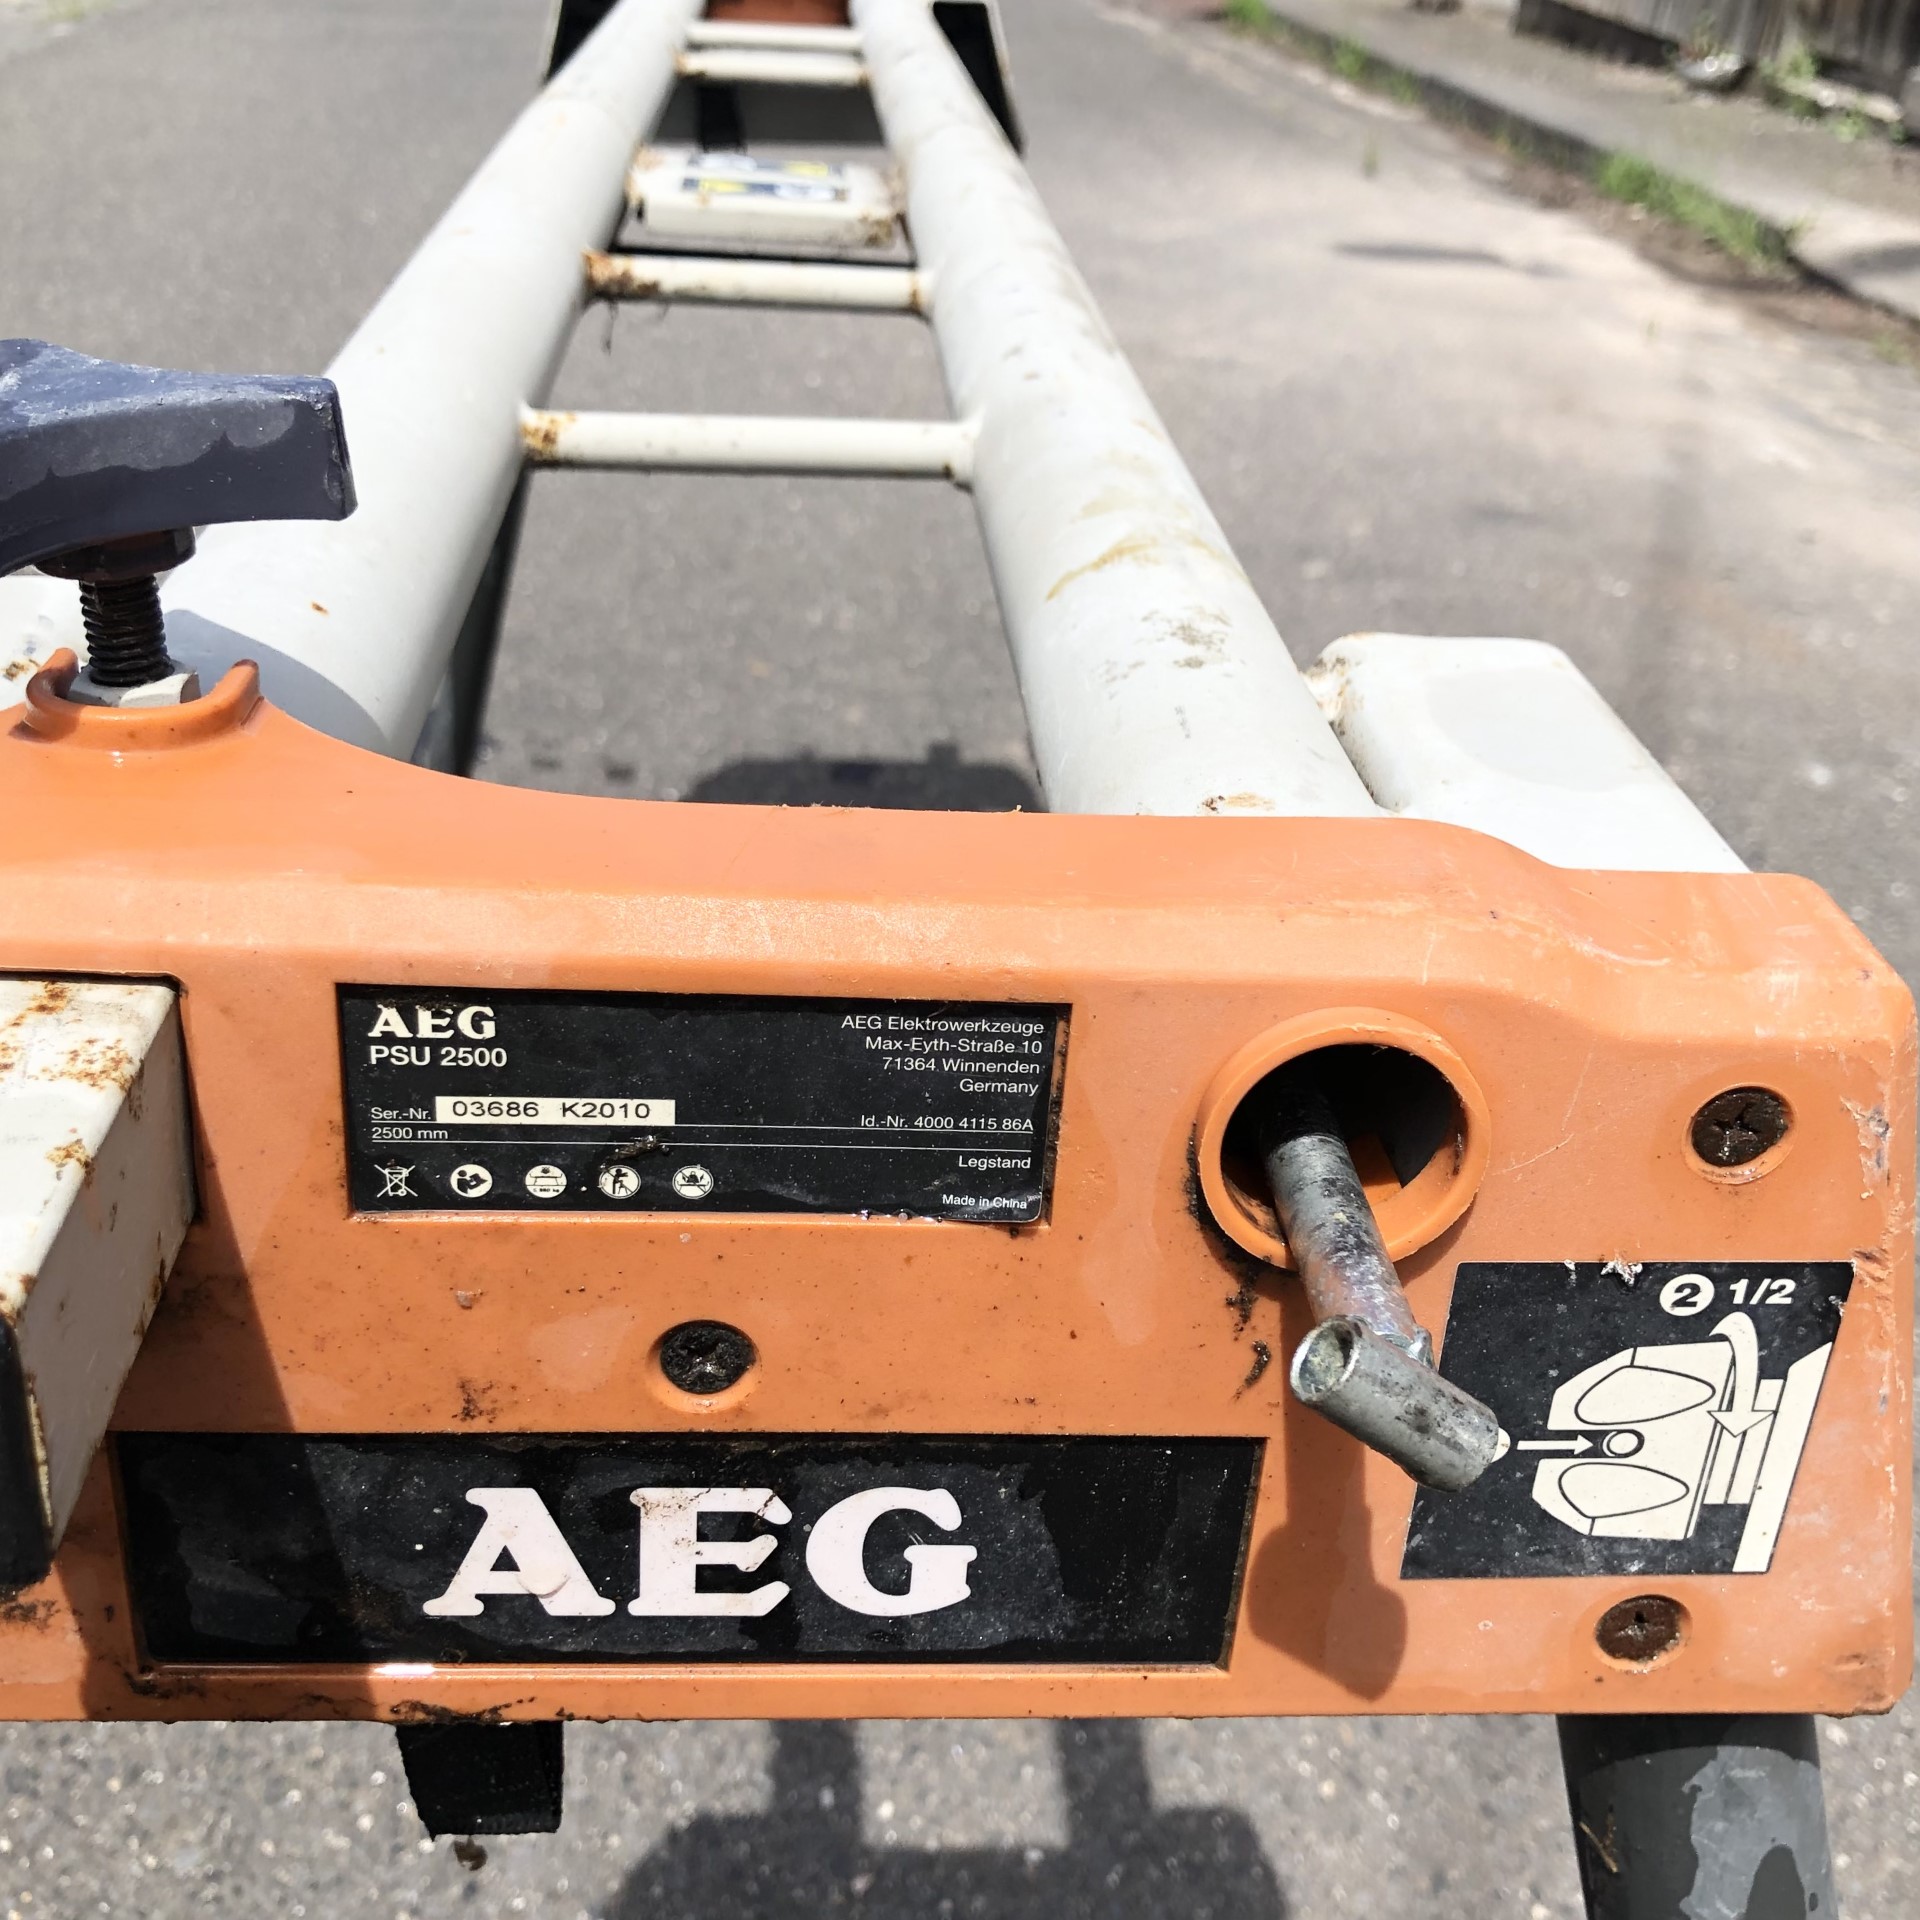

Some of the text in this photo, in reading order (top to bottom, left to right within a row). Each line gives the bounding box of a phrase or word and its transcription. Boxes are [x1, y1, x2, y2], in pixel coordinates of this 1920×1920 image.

[368, 1004, 496, 1040] AEG
[841, 1015, 1044, 1034] AEG Elektrowerkzeuge
[865, 1036, 1042, 1054] Max-Eyth-Straße 10
[370, 1045, 508, 1068] PSU 2500
[882, 1057, 1040, 1074] 71364 Winnenden
[959, 1079, 1039, 1096] Germany
[371, 1100, 651, 1120] Ser.-Nr. 03686 K2010
[860, 1115, 1034, 1131] Id.-Nr. 4000 4115 86A
[371, 1126, 448, 1140] 2500 mm
[958, 1155, 1031, 1171] Legstand
[942, 1194, 1028, 1210] Made in China
[1729, 1278, 1796, 1306] 1/2
[422, 1486, 978, 1618] AEG
